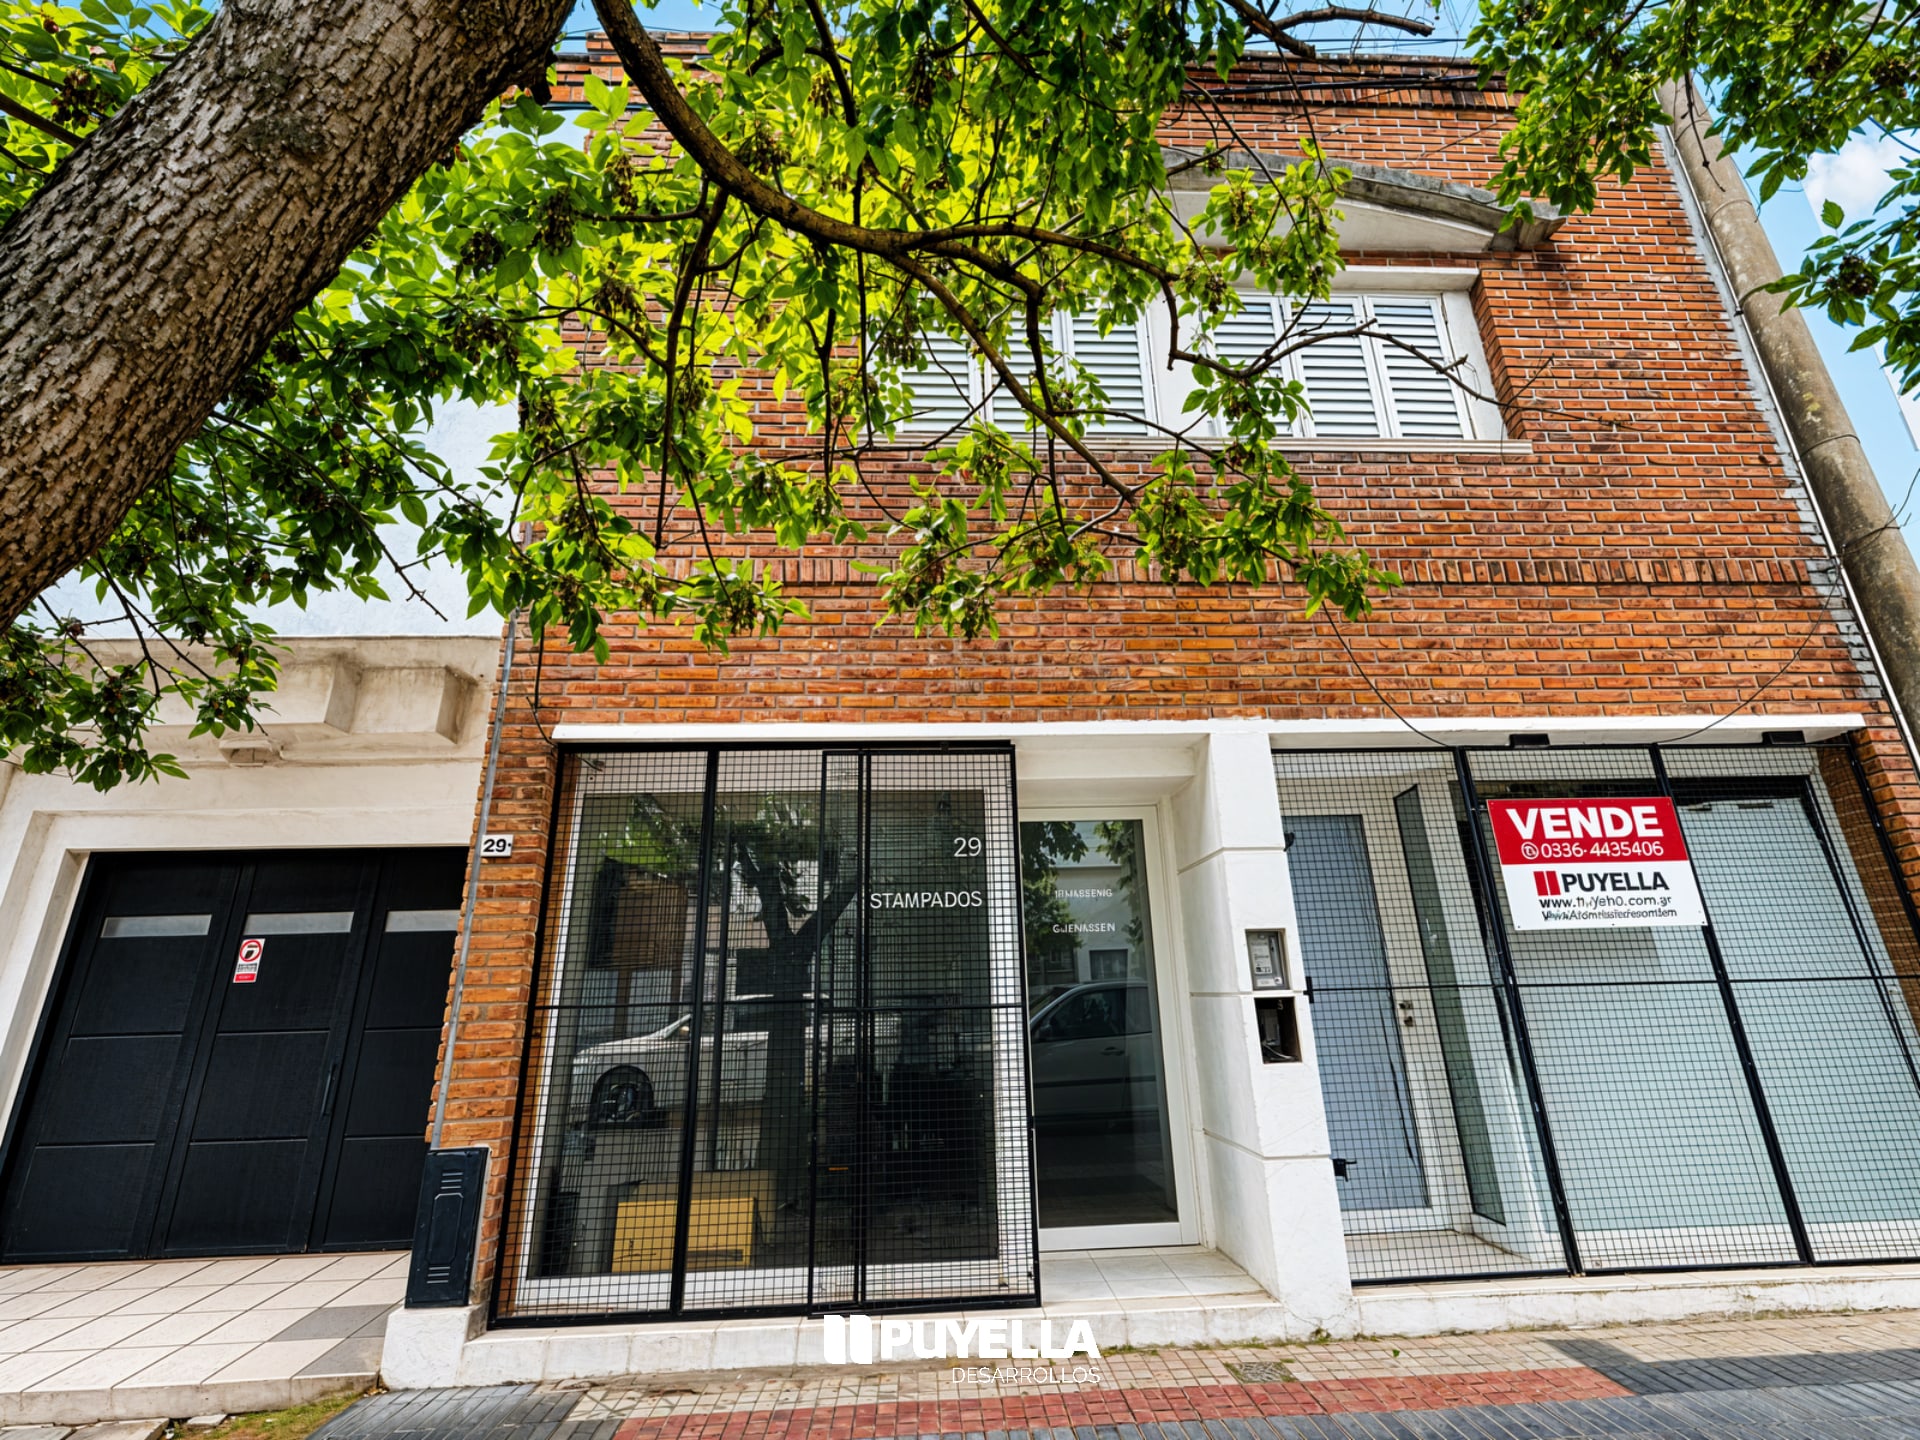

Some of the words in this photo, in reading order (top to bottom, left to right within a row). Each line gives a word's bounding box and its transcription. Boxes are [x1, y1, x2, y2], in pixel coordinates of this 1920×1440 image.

[1505, 806, 1664, 840] VENDE
[953, 836, 982, 857] 29
[1561, 871, 1670, 893] PUYELLA
[869, 890, 983, 909] STAMPADOS
